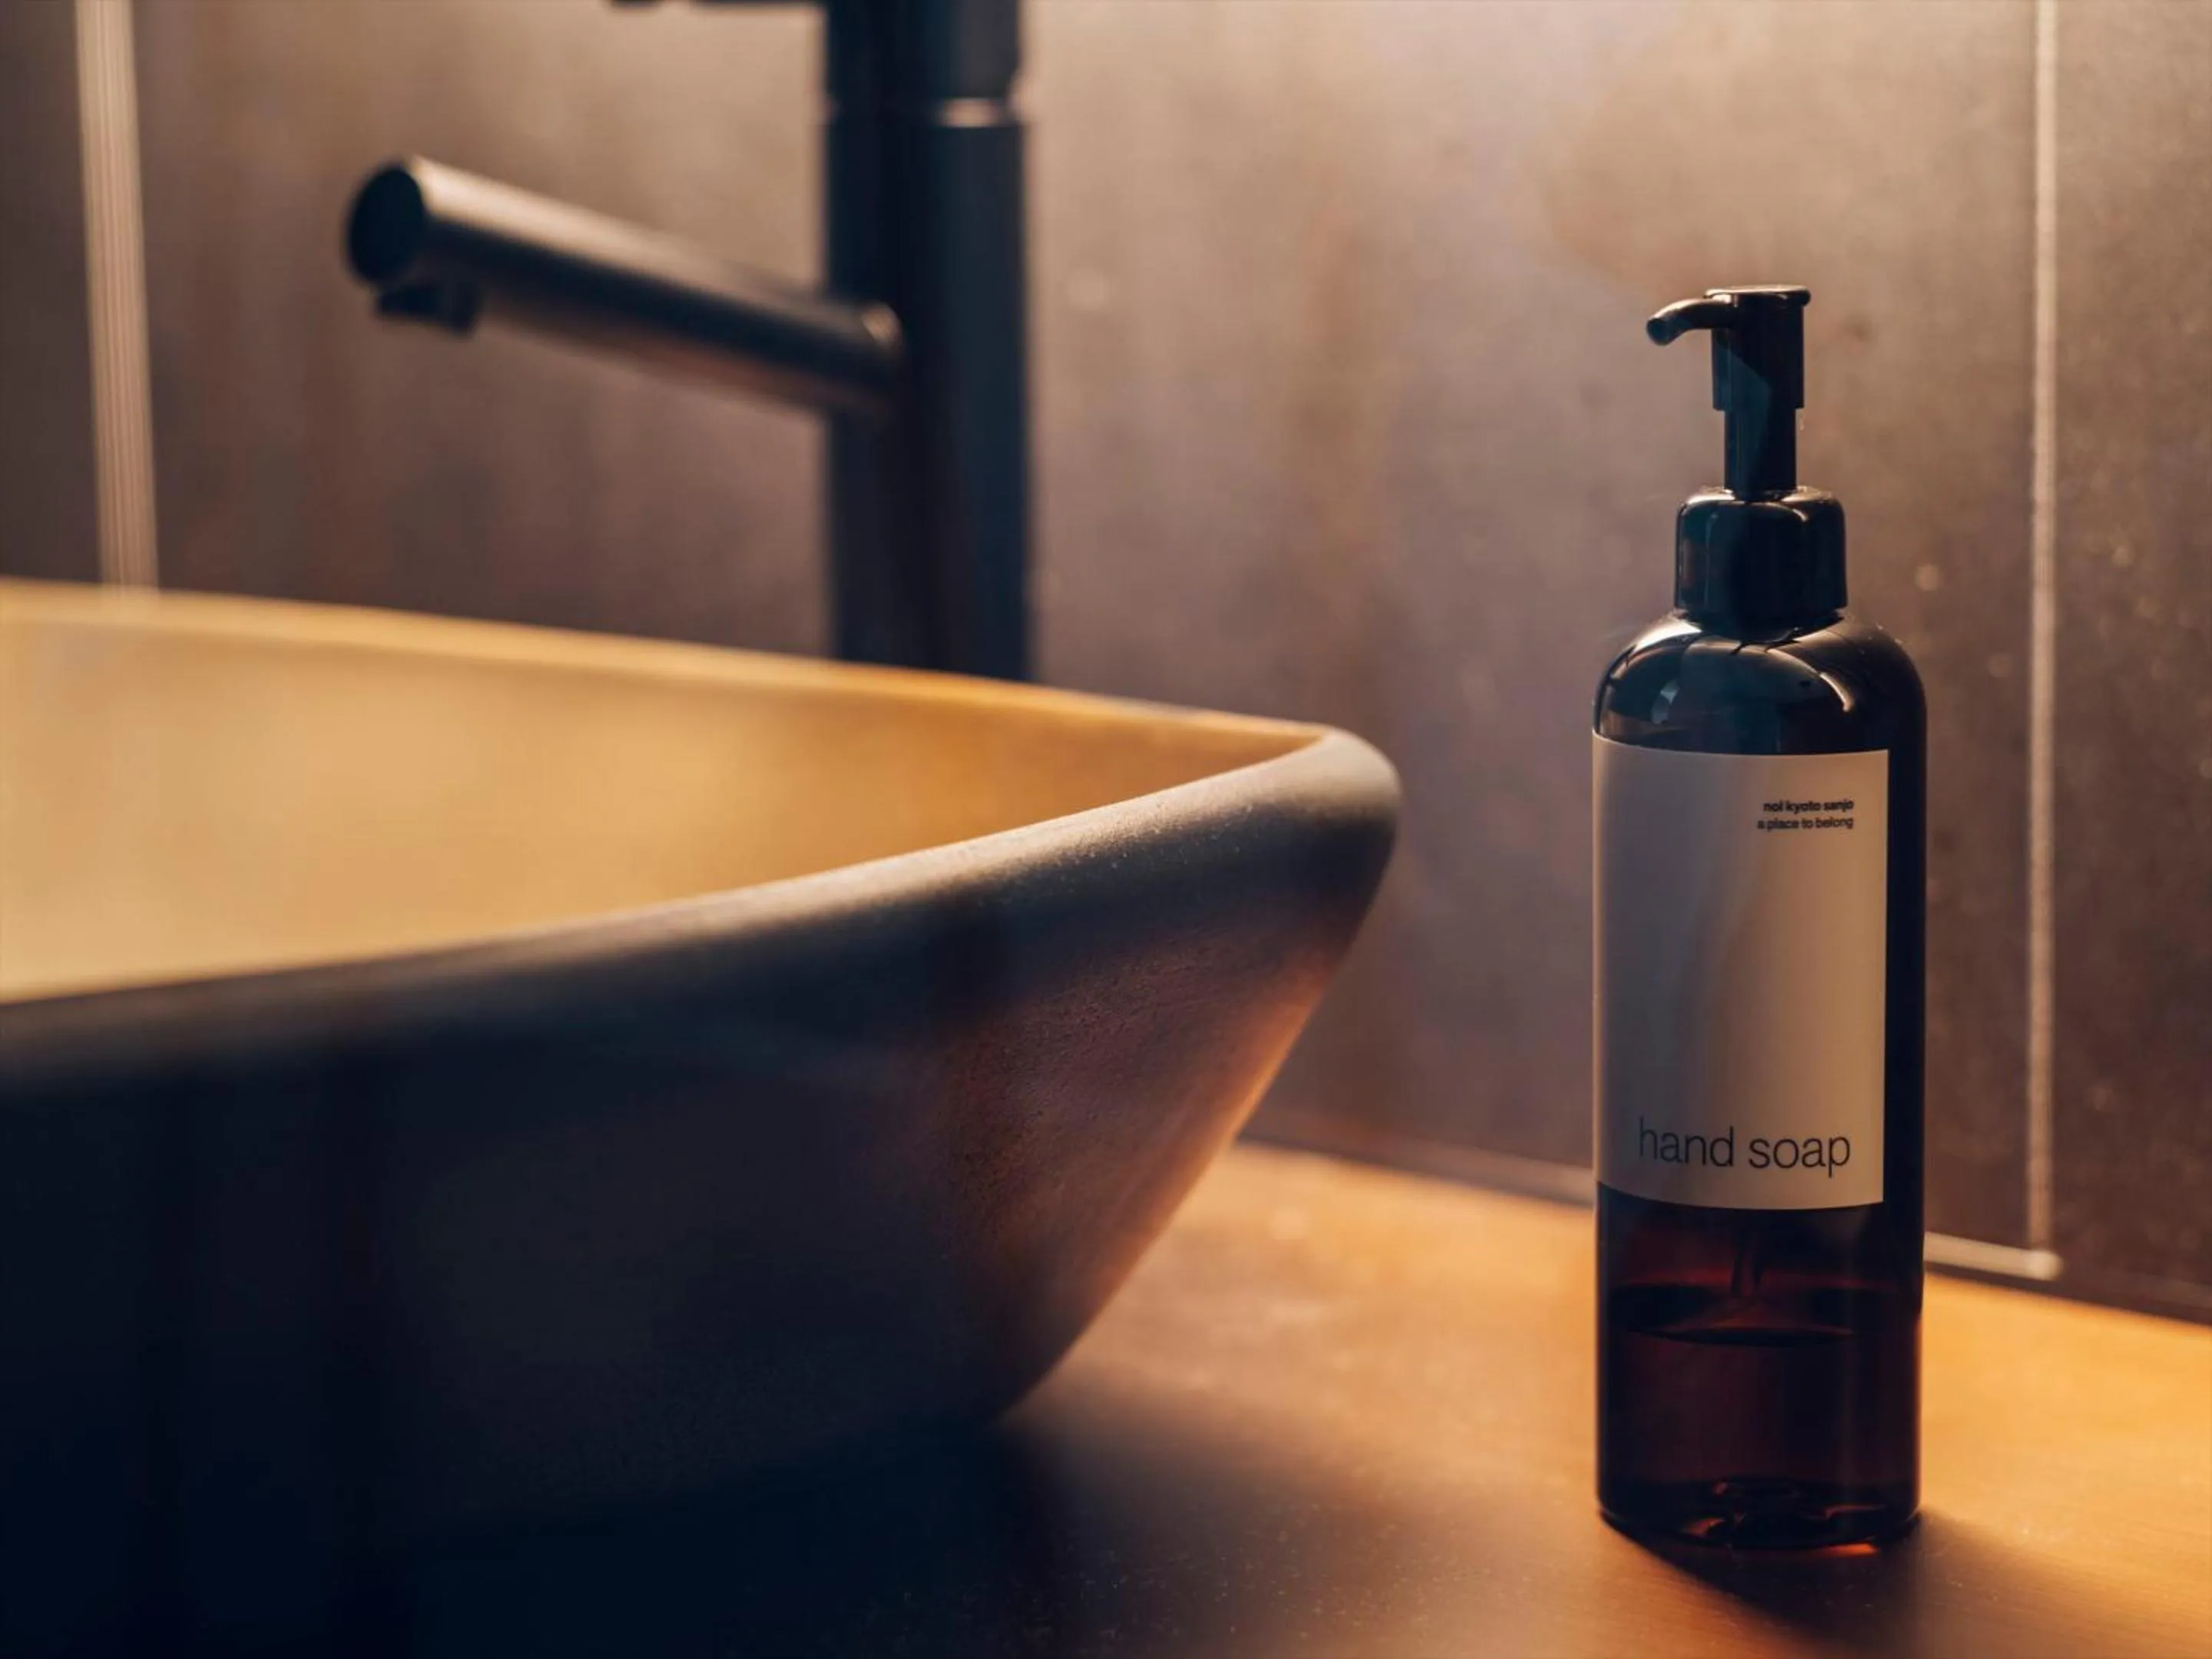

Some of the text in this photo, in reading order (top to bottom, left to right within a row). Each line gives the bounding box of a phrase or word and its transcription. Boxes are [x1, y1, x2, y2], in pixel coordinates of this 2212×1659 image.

[1786, 800, 1821, 814] kyoto
[1757, 816, 1853, 832] a place to belong
[1638, 1116, 1850, 1179] hand soap
